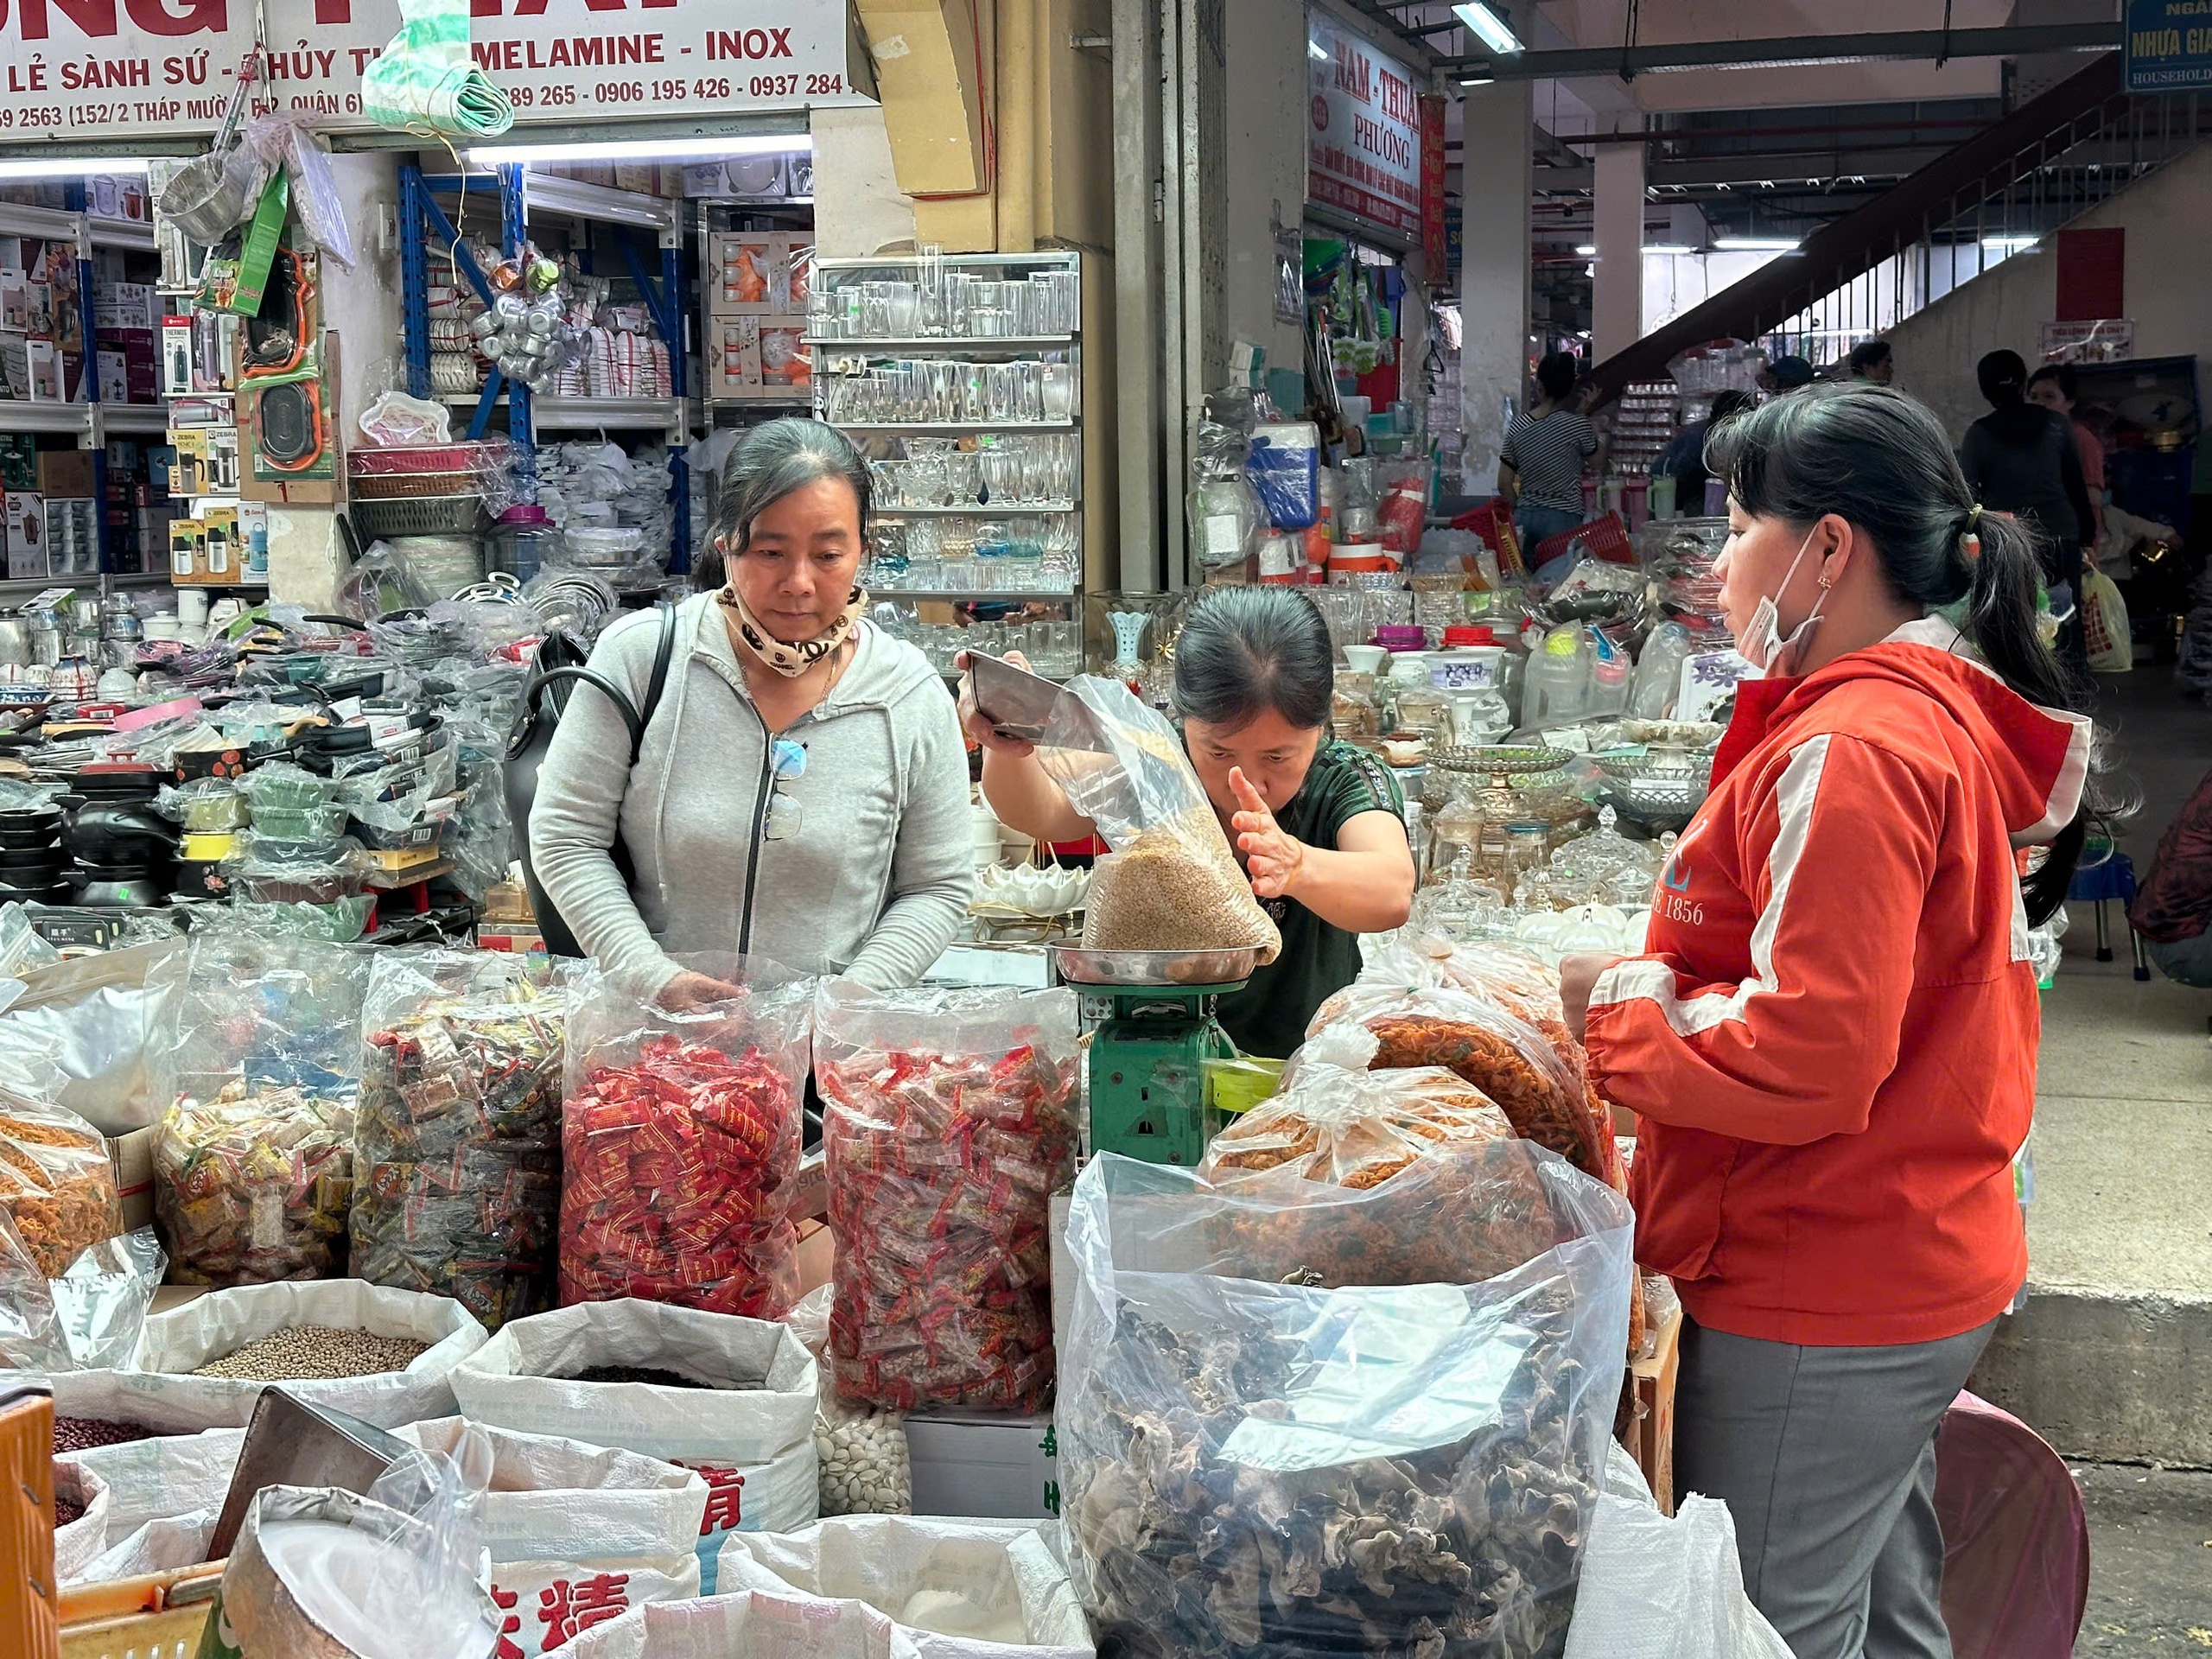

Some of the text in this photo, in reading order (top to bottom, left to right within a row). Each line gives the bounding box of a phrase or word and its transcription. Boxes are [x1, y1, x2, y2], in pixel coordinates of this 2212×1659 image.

[471, 33, 664, 71] MELAMINE
[705, 28, 793, 60] INOX
[8, 53, 48, 92] LẺ
[60, 54, 150, 90] SÀNH
[163, 48, 210, 85] SỨ
[1335, 40, 1371, 104] NAM
[2133, 69, 2212, 85] HOUSEHOLD
[499, 86, 533, 107] 89
[540, 85, 575, 106] 265
[594, 82, 644, 104] 0906
[652, 79, 686, 101] 195
[693, 78, 730, 99] 426
[749, 74, 799, 97] 0937
[805, 73, 842, 95] 284
[19, 106, 62, 127] 2563
[133, 96, 181, 122] THÁP
[345, 92, 363, 115] 6)
[1664, 894, 1704, 925] 1856
